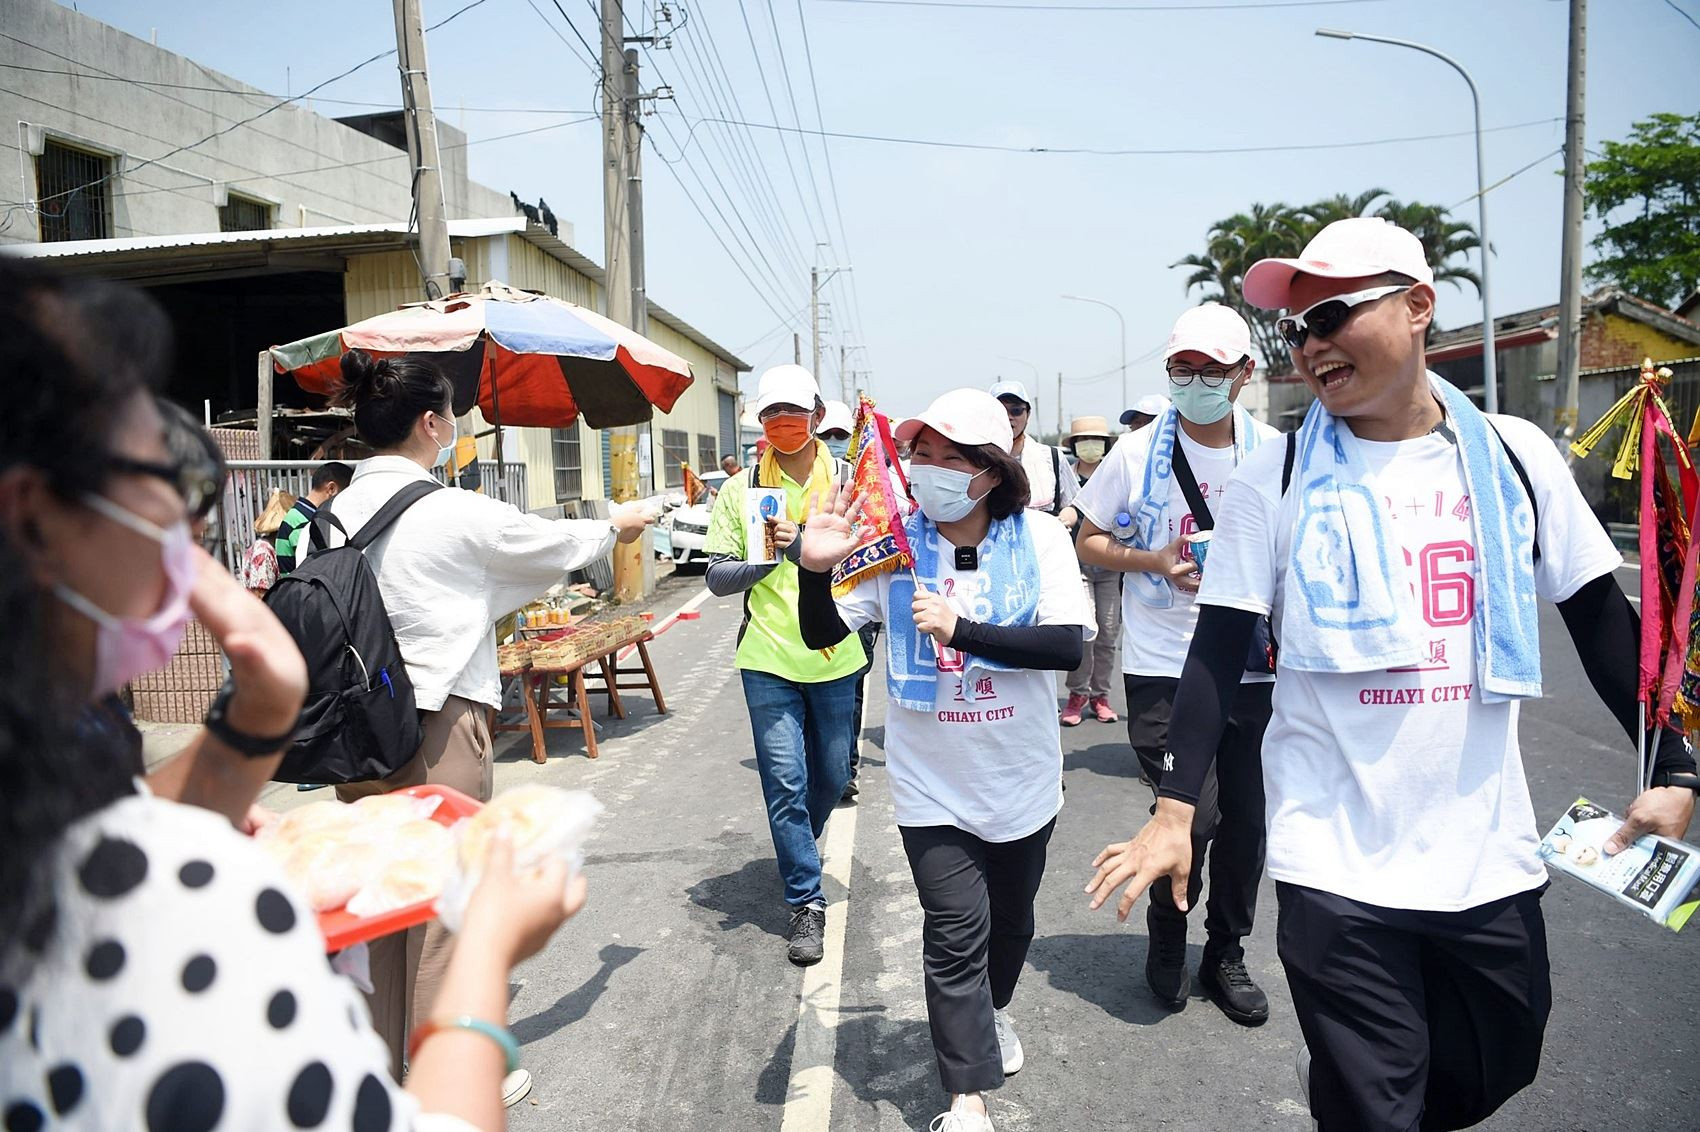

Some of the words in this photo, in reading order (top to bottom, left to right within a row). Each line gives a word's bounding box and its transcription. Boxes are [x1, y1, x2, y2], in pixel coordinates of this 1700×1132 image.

[1359, 688, 1425, 705] CHIAYI
[1431, 683, 1473, 702] CITY
[938, 710, 981, 723] CHIAYI
[986, 705, 1016, 722] CITY
